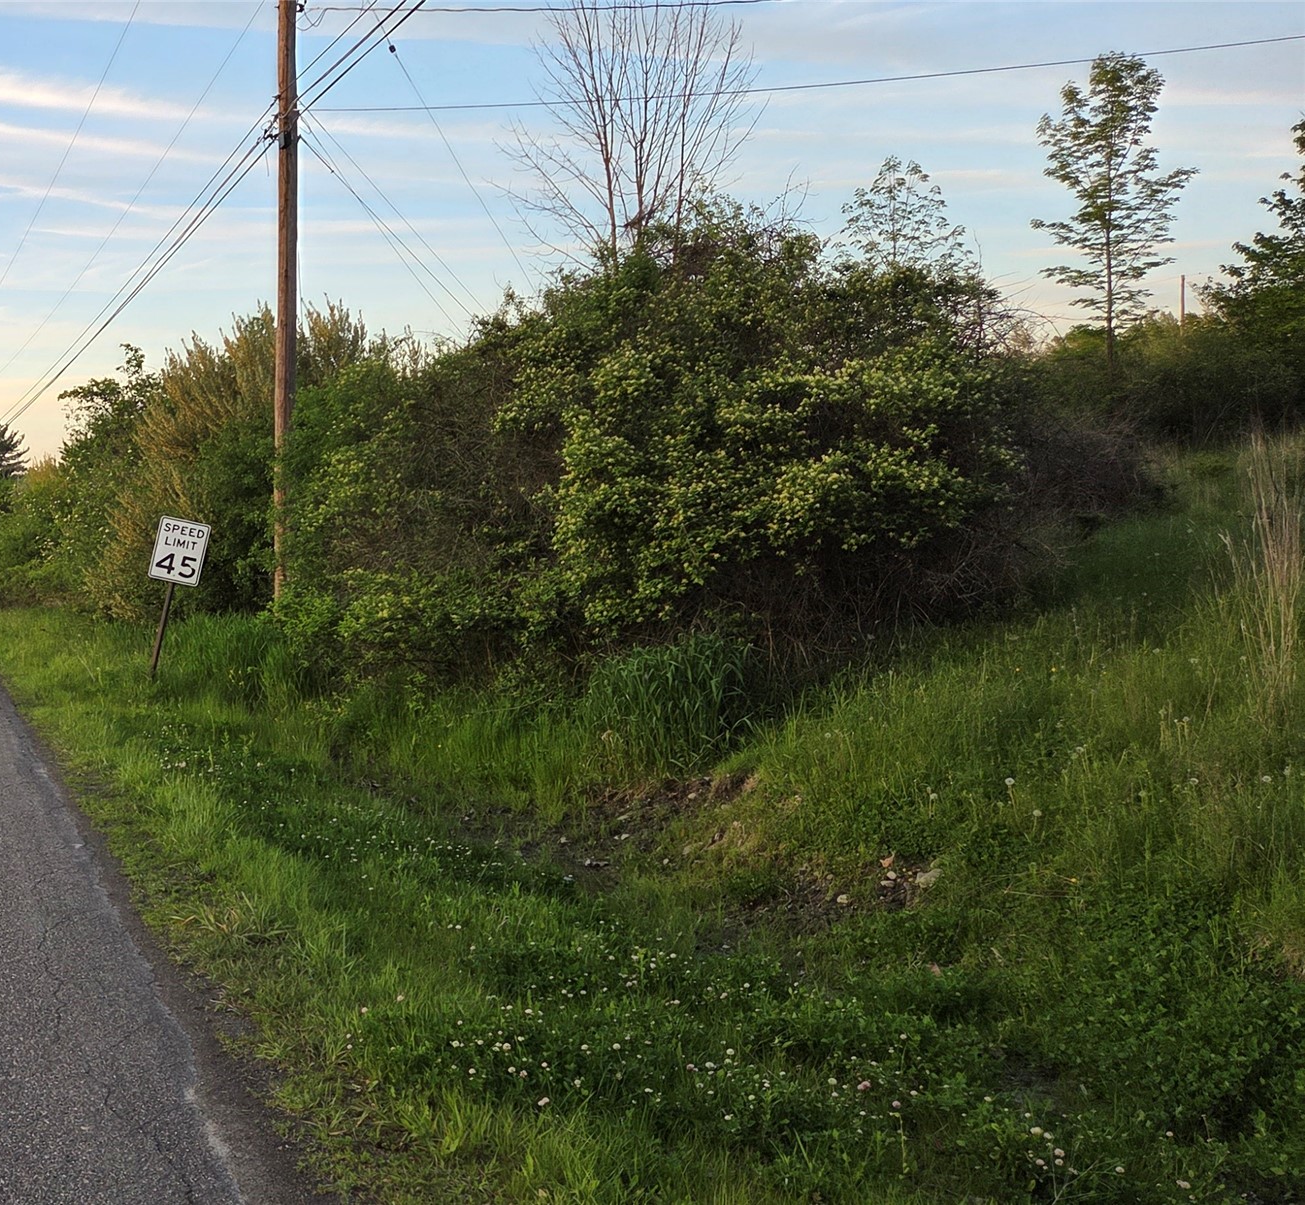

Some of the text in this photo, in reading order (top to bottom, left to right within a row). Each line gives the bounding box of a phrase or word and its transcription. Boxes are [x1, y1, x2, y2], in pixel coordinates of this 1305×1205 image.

[163, 523, 205, 539] SPEED
[164, 536, 198, 550] LIMIT
[155, 553, 197, 578] 45
